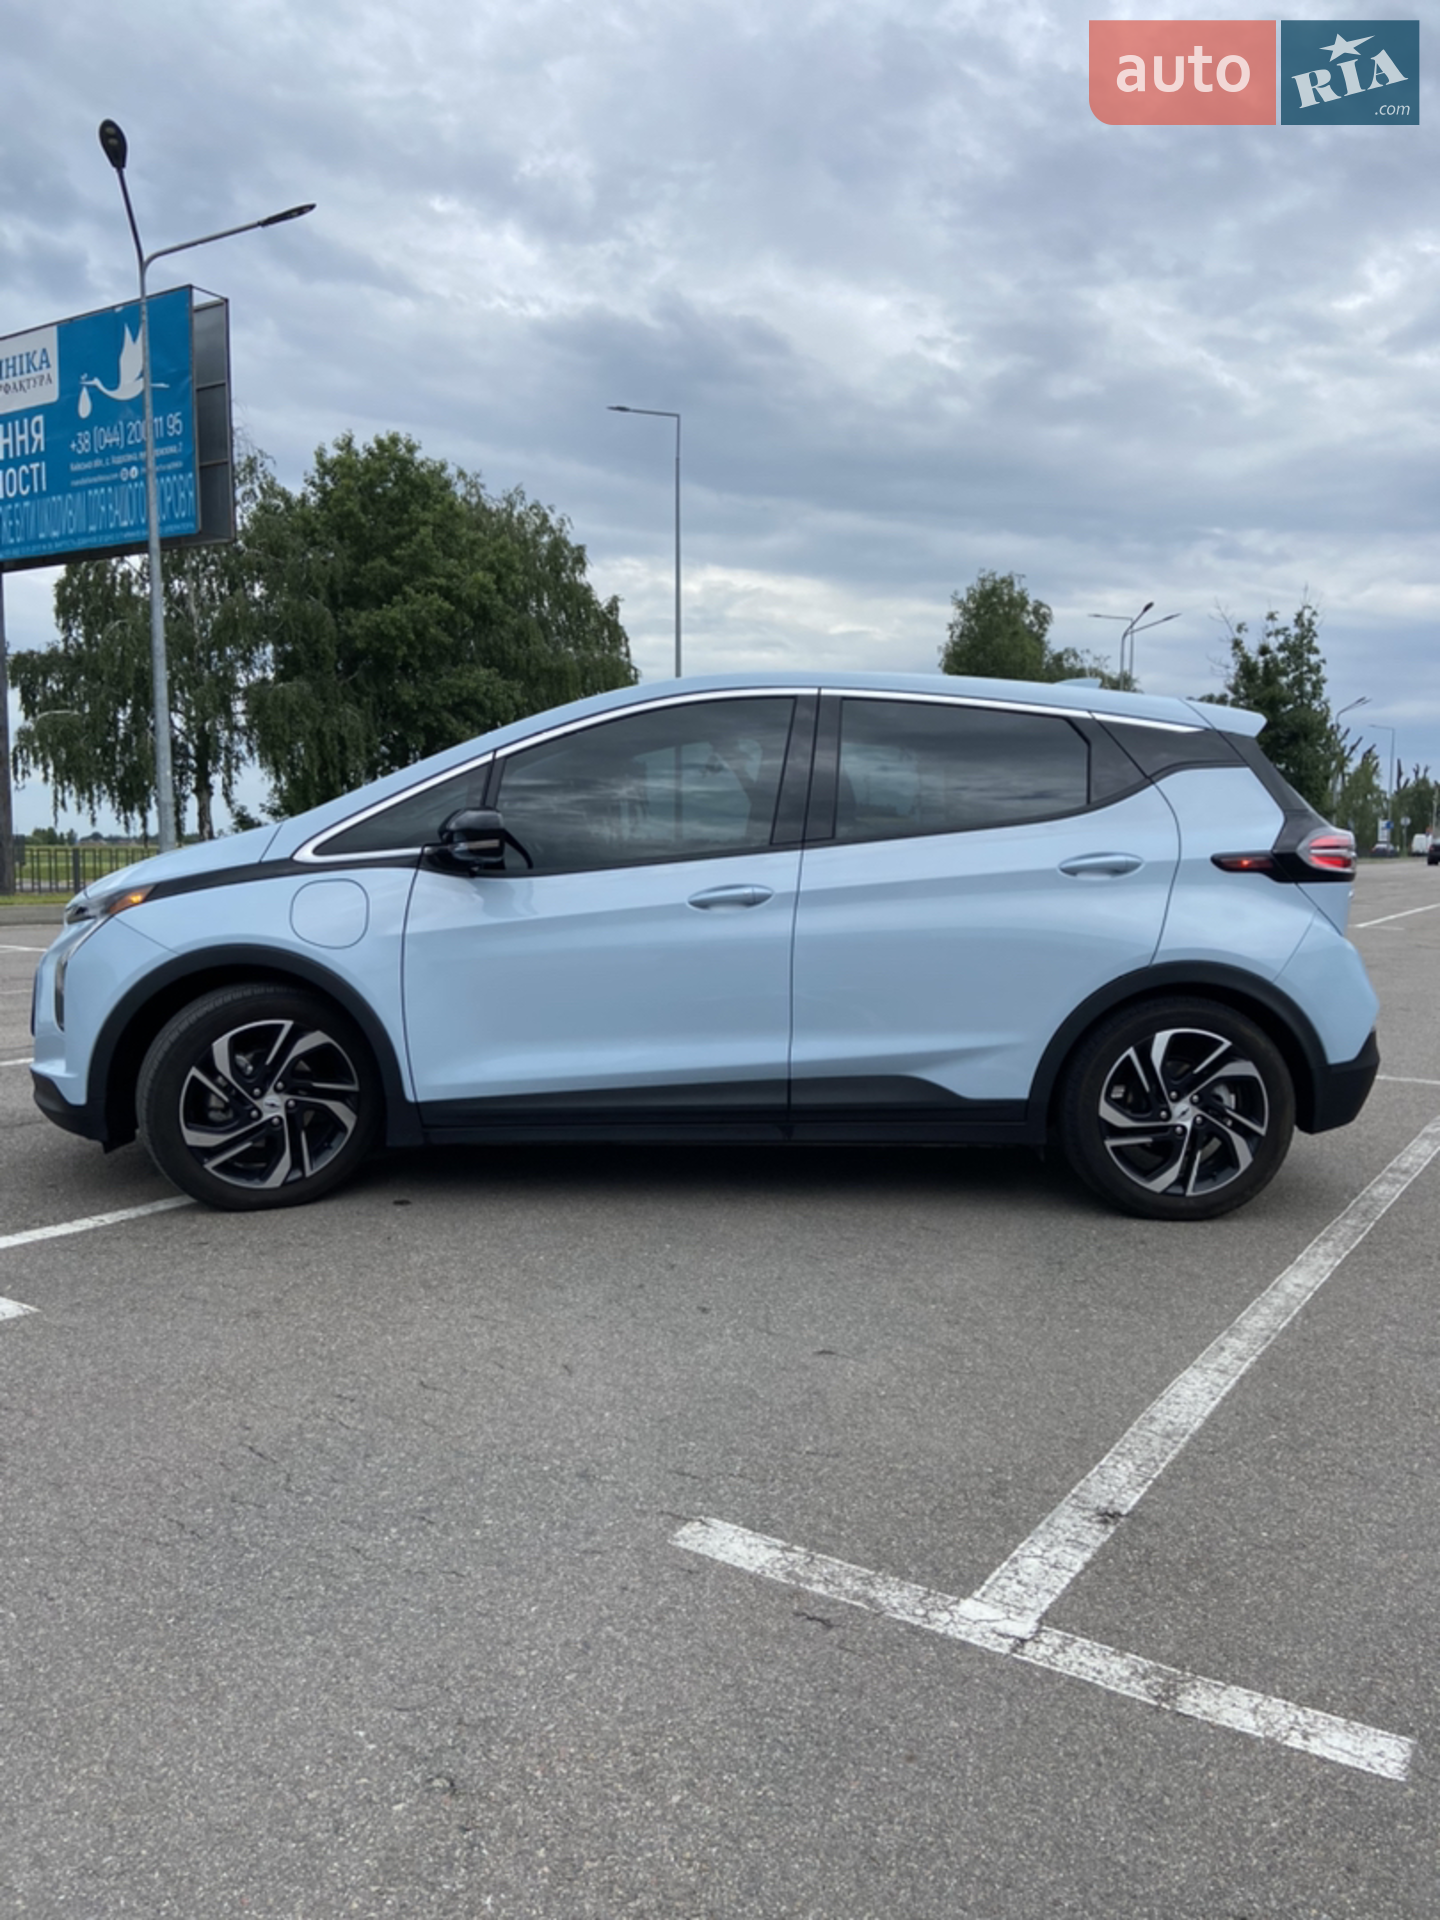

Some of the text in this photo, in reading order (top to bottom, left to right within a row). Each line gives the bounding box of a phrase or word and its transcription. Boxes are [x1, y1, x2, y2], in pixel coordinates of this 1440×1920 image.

[69, 430, 91, 454] +38
[93, 421, 125, 454] (044)
[166, 411, 183, 436] 95
